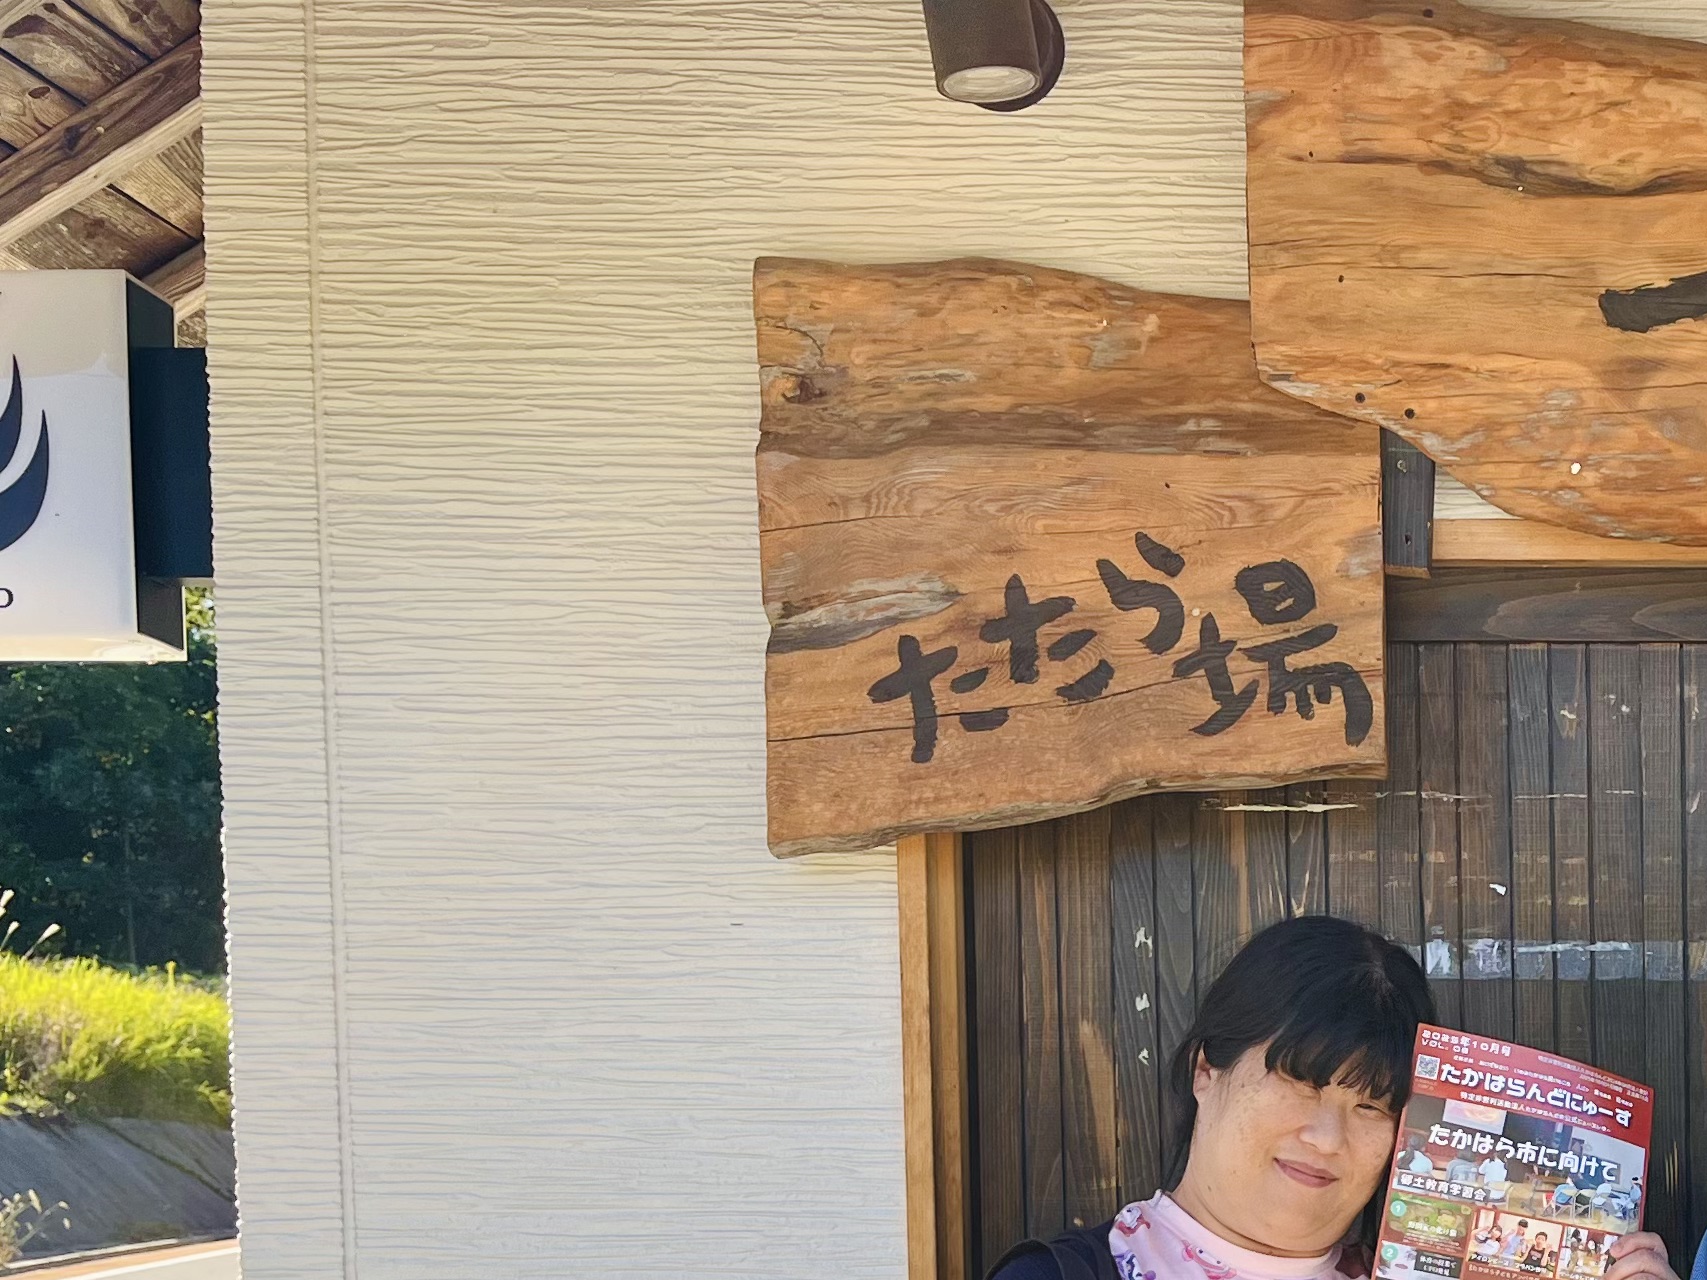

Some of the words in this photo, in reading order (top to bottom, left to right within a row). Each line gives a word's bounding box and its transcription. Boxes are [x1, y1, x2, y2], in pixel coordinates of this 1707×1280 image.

[867, 531, 1374, 763] たたら場
[1440, 1063, 1632, 1127] たかはらんどにゅーす
[1428, 1123, 1618, 1181] たかはら市に向けて
[1400, 1174, 1488, 1201] 郷土教育学習会
[1385, 1248, 1394, 1257] 2
